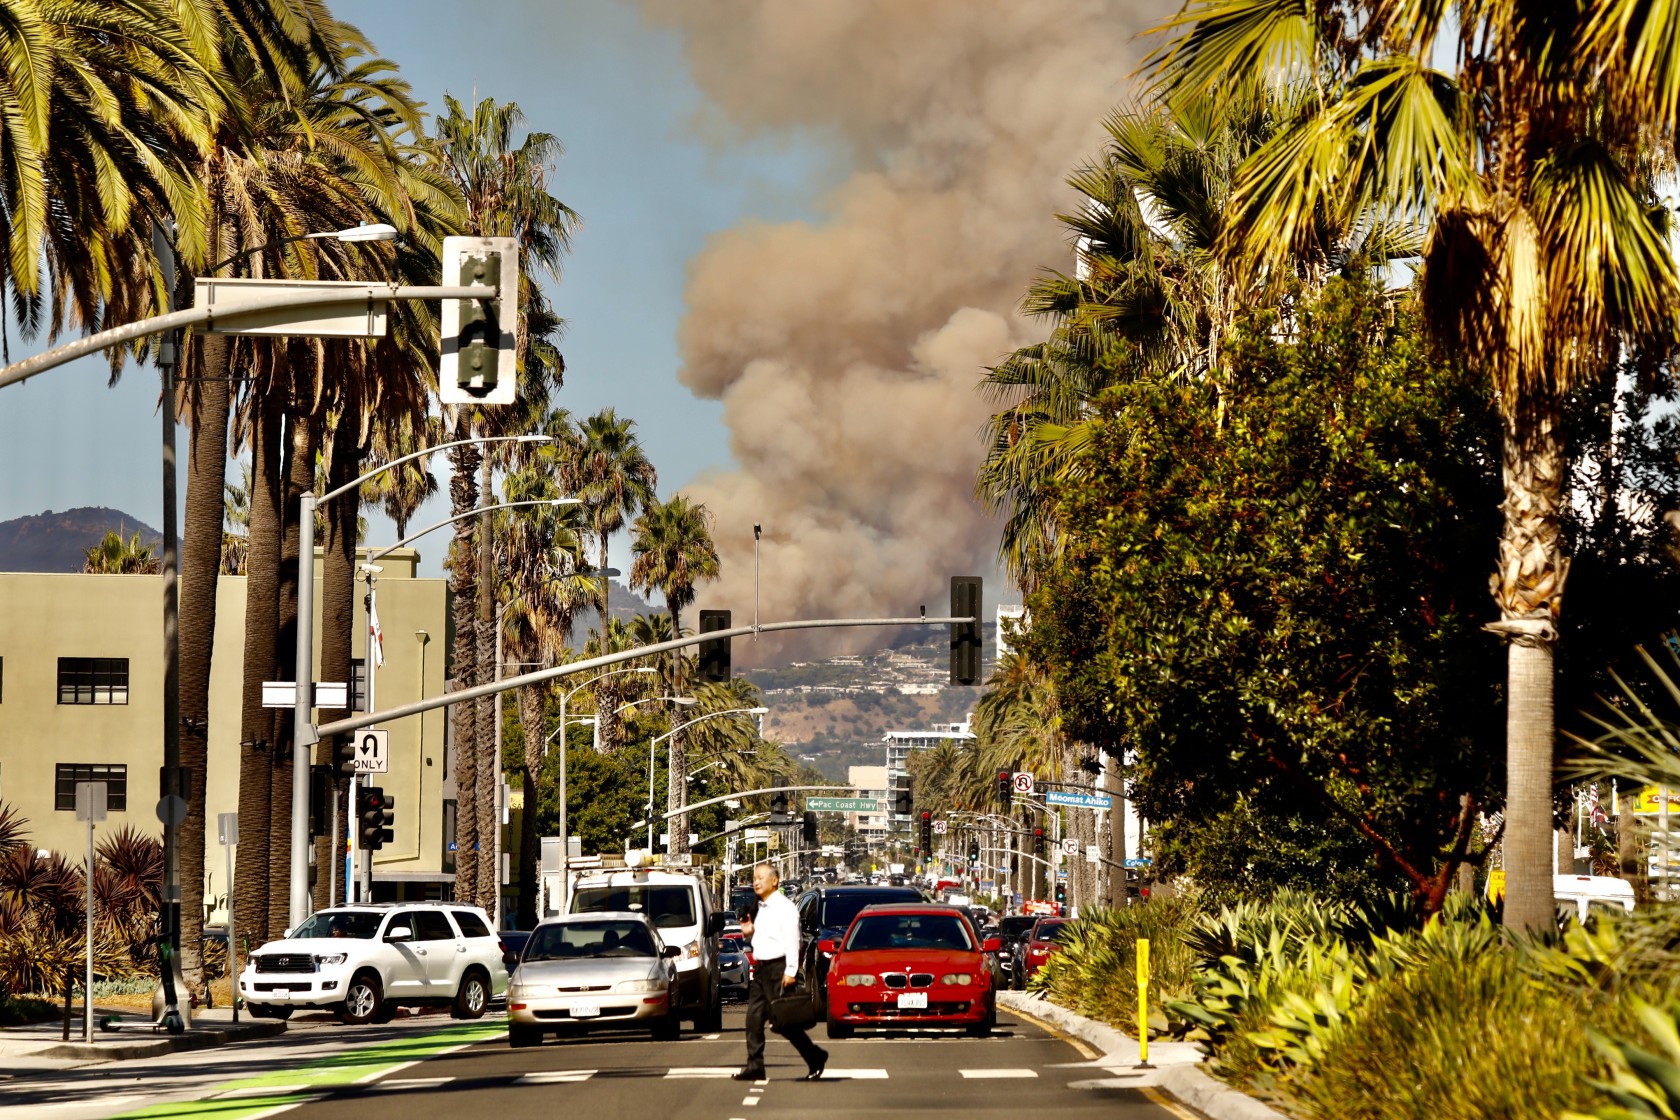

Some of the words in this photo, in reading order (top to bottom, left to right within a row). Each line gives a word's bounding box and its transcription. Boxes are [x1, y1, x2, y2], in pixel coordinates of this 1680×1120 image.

[353, 760, 383, 769] ONLY
[1049, 793, 1084, 804] Moomat
[1084, 796, 1109, 806] Ahiko
[818, 800, 832, 808] Pac
[835, 801, 856, 809] Coast
[860, 801, 877, 811] Hwy
